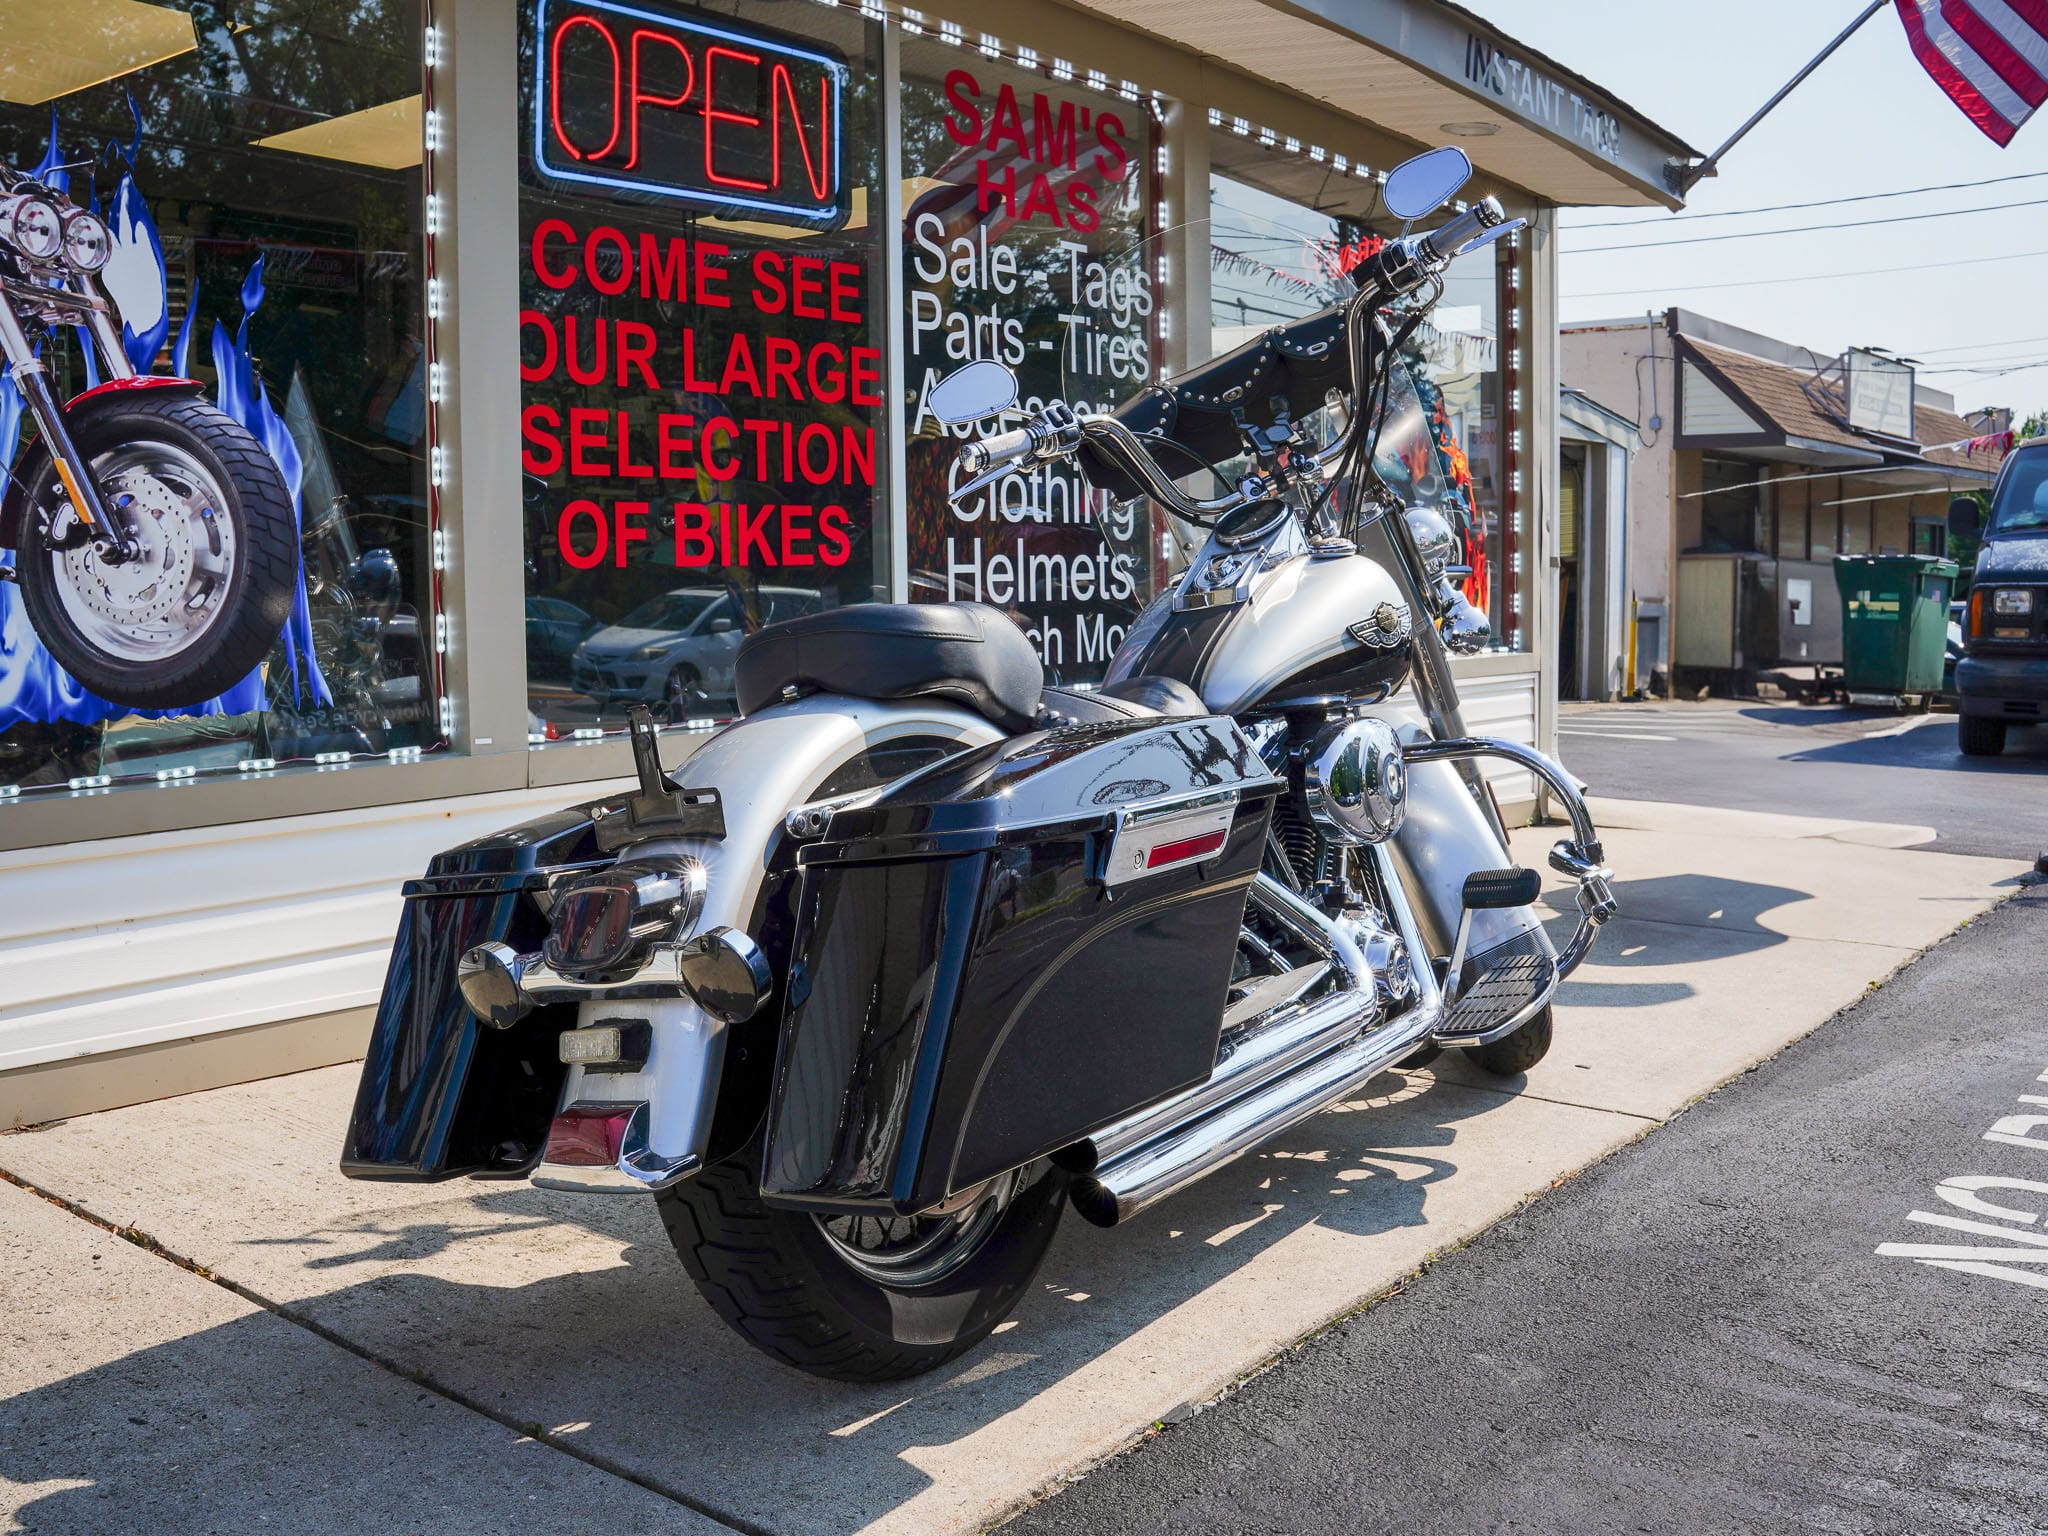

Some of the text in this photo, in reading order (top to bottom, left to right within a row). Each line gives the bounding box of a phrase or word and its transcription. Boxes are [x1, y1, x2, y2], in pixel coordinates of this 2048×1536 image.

[551, 15, 829, 202] OPEN
[944, 69, 1127, 182] SAM'S
[1464, 33, 1564, 128] INSTANT
[976, 160, 1100, 234] HAS
[531, 218, 862, 324] COME SEE
[913, 212, 1018, 295] Sale
[1060, 240, 1153, 329] Tags
[518, 309, 883, 408] OUR LARGE
[911, 290, 1026, 366] Parts
[1057, 313, 1150, 381] Tires
[520, 403, 876, 488] SELECTION
[557, 499, 851, 570] OF BIKES
[948, 455, 1135, 541] Clothing
[947, 537, 1136, 604] Helmets
[1076, 613, 1132, 664] Mo
